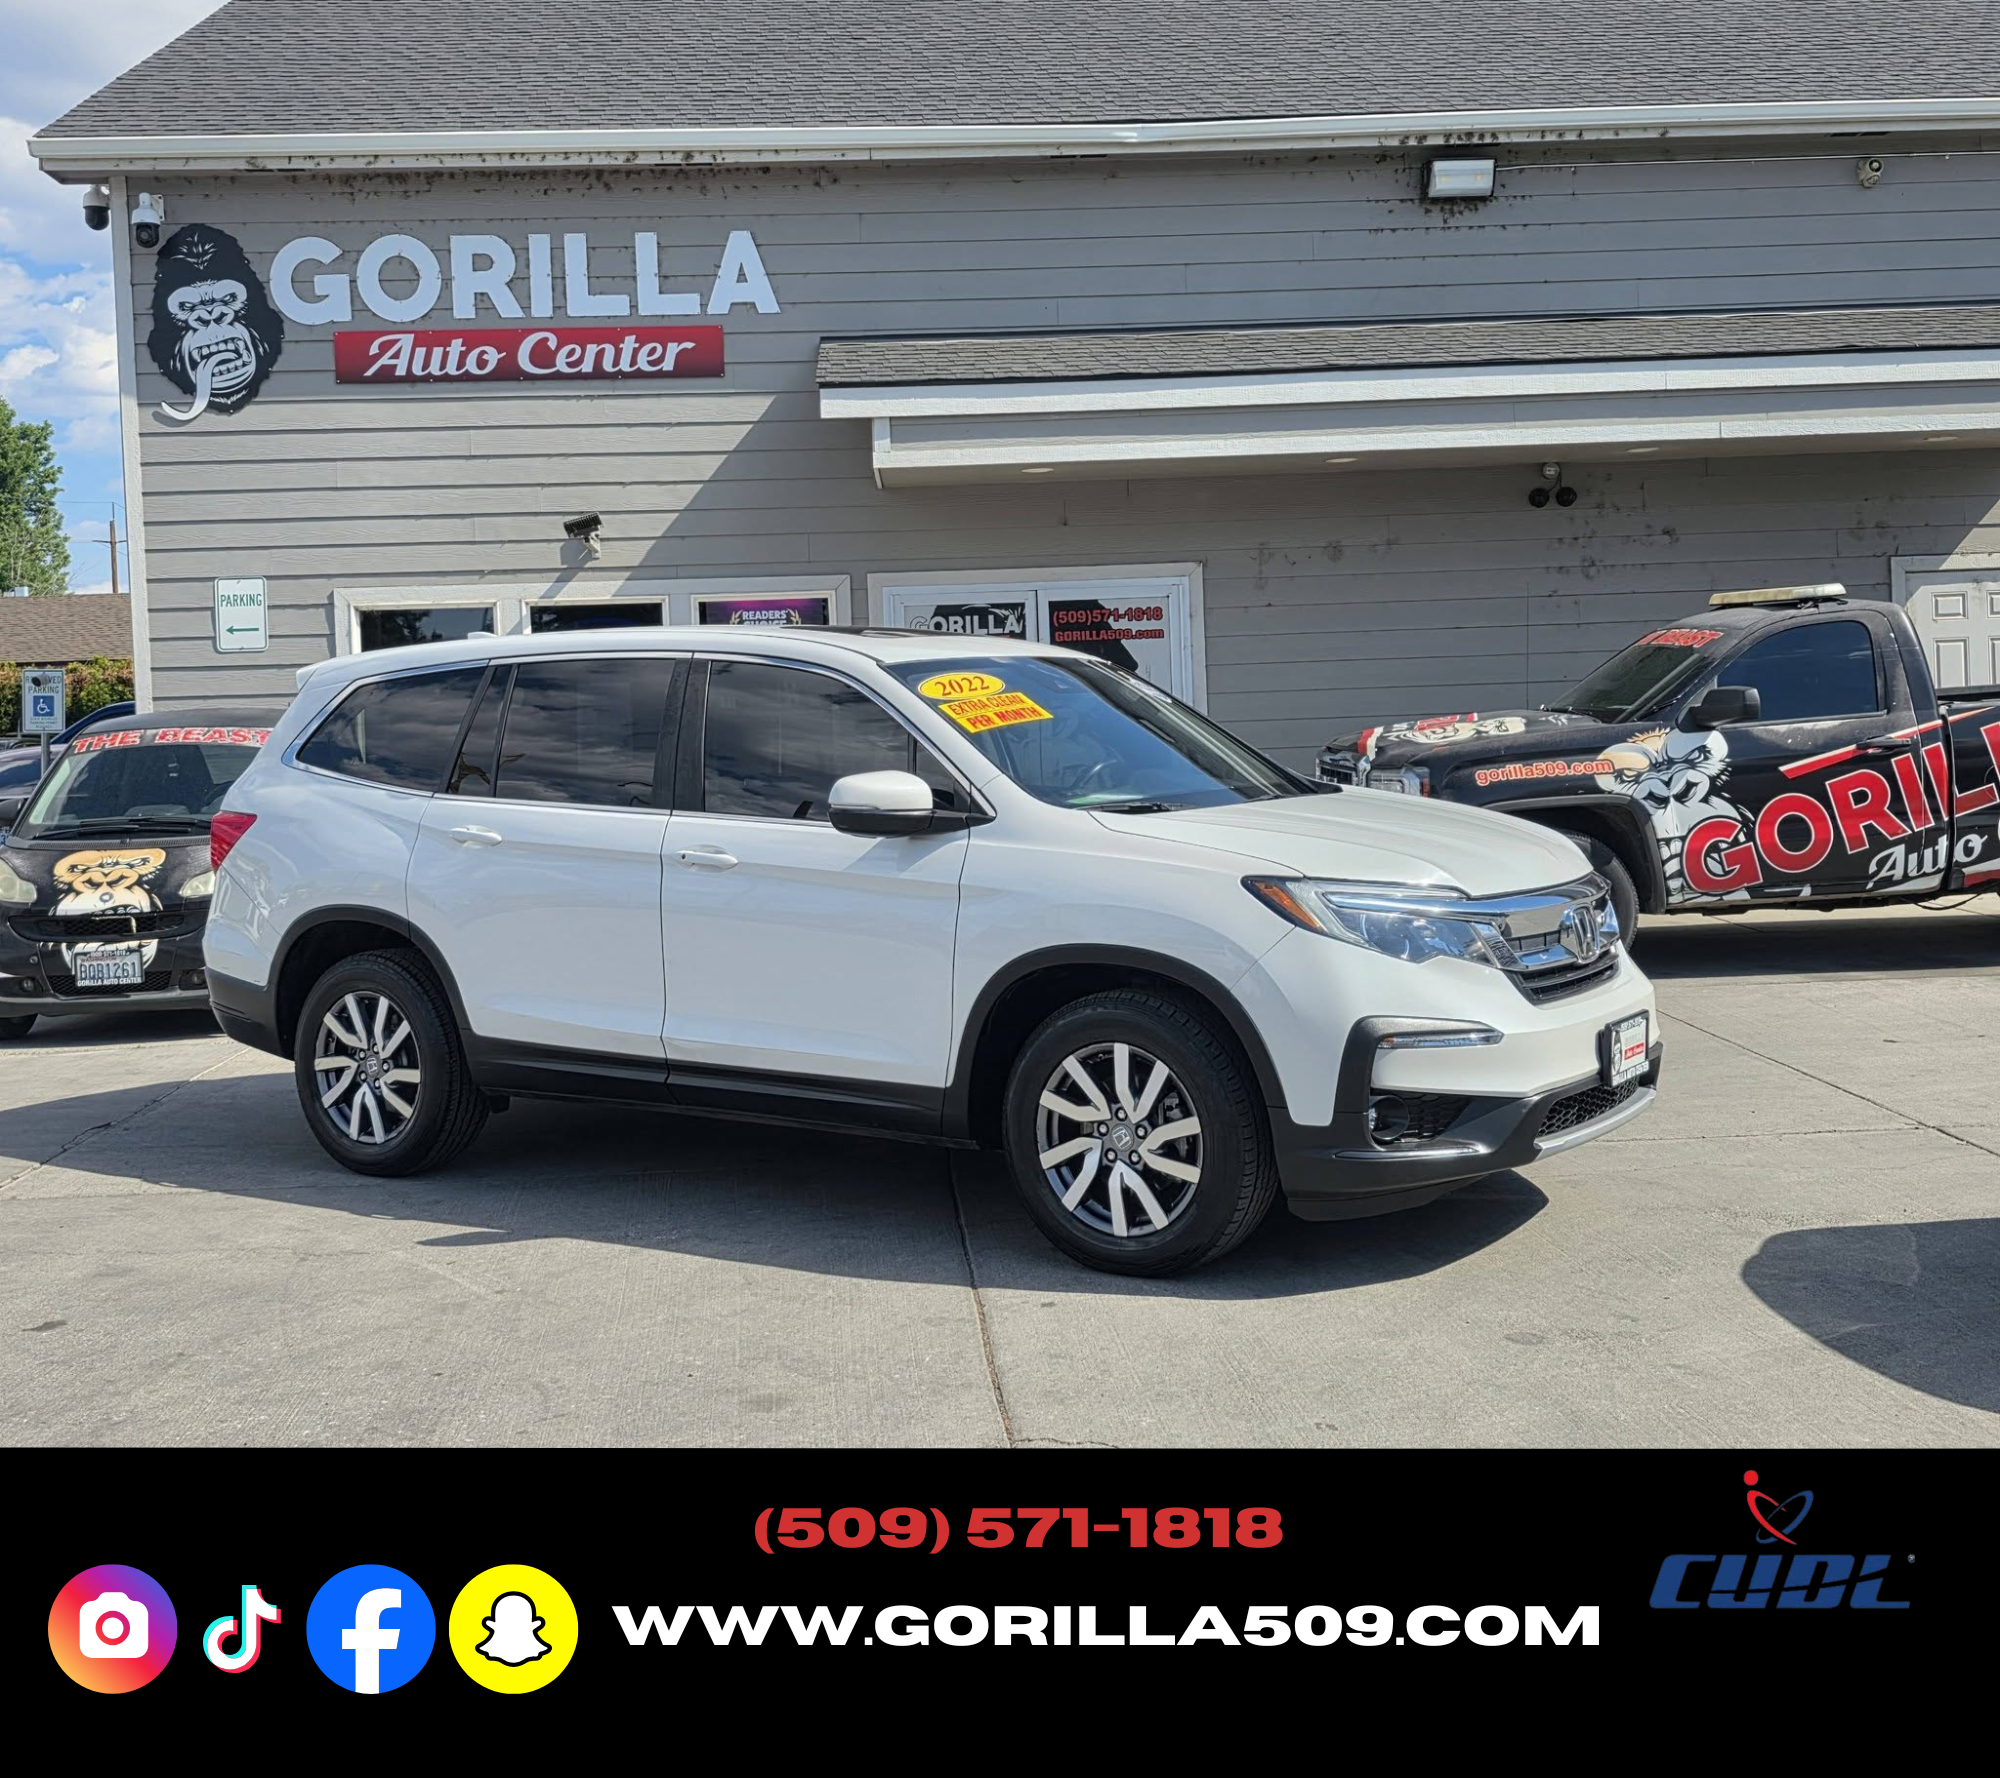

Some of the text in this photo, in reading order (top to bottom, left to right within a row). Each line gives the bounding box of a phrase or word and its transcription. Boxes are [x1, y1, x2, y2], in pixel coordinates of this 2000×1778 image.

[270, 230, 781, 325] GORILLA
[363, 331, 696, 377] Auto Center
[220, 593, 262, 607] PARKING
[1052, 606, 1163, 626] (509)571-1818
[25, 675, 62, 684] RVED
[28, 685, 60, 694] PARKING
[934, 676, 990, 696] 2022
[946, 694, 1026, 716] EXTRA CLEAN
[966, 706, 1044, 729] PER MONTH
[73, 727, 273, 754] THE BEAST
[1475, 758, 1614, 786] gorilla509.com
[1866, 833, 1988, 890] Auto
